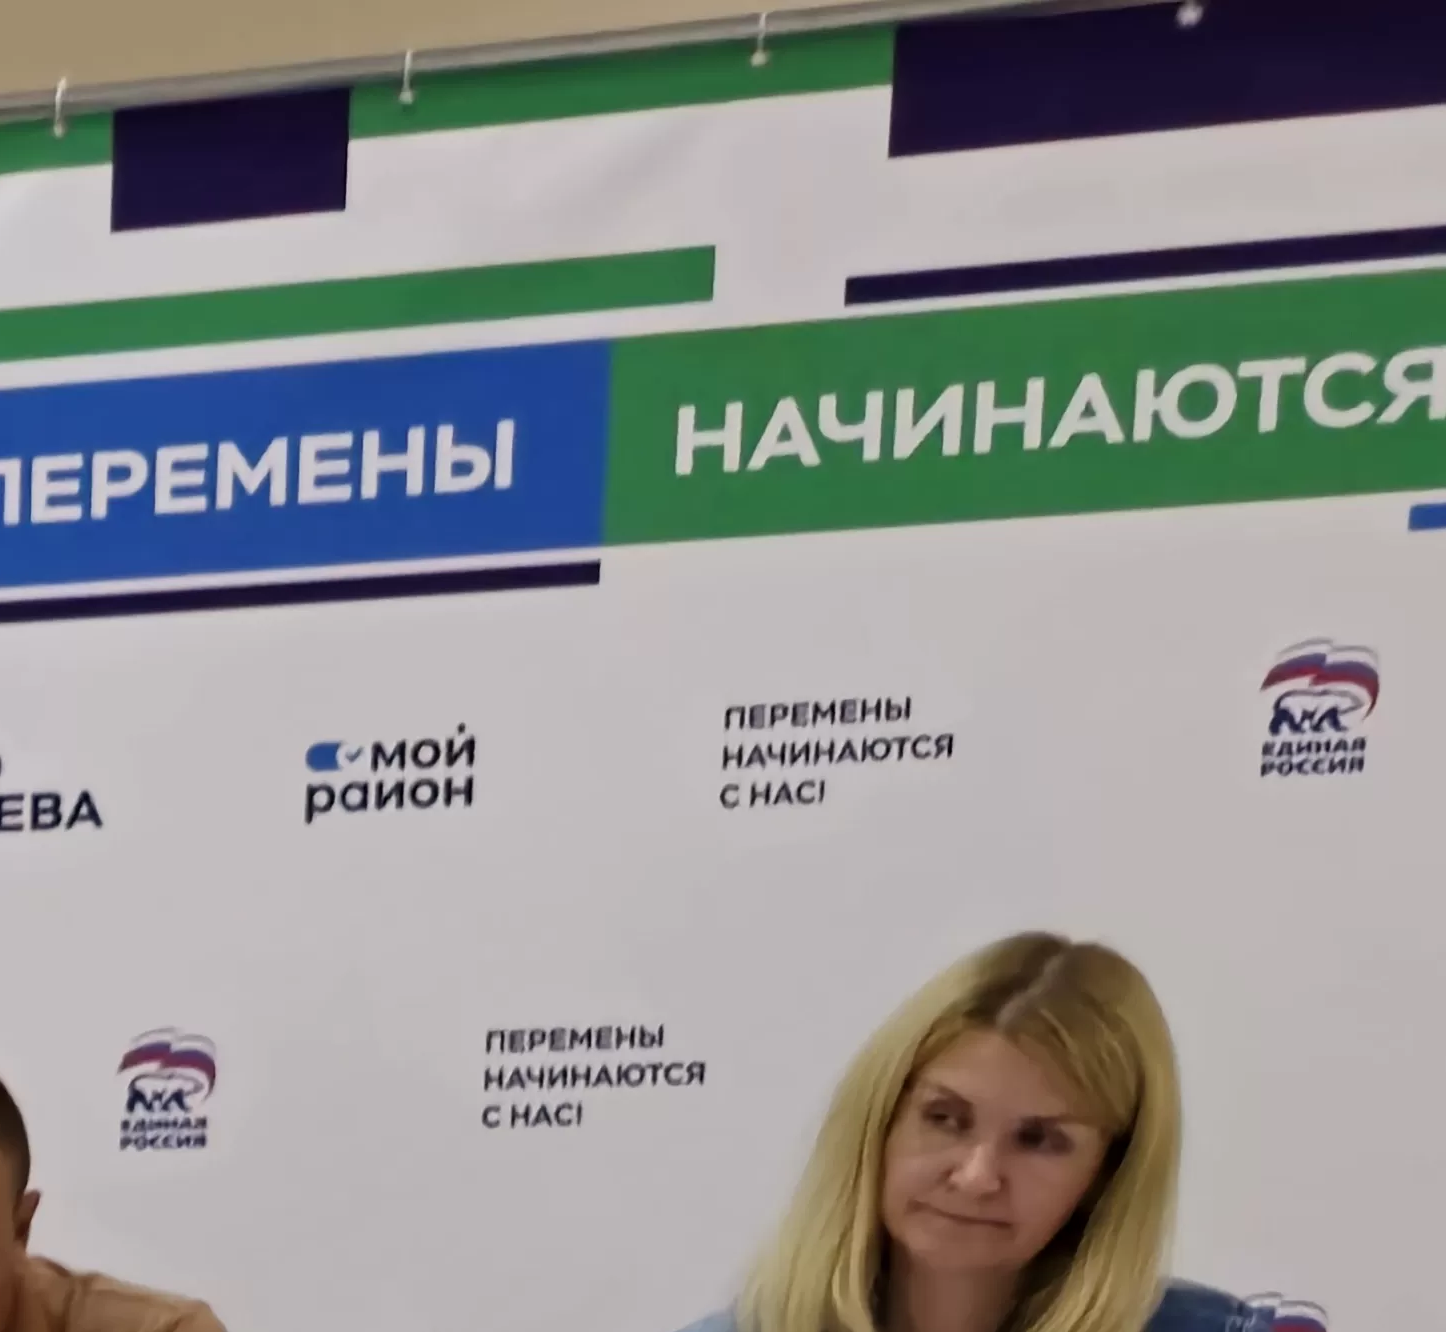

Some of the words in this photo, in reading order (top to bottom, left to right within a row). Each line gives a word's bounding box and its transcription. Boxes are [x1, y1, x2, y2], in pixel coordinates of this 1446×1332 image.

[674, 344, 1446, 475] НАЧИНАЮТСЯ
[723, 696, 912, 732] ПЕРЕМЕНЫ
[371, 722, 477, 774] мой
[721, 733, 955, 771] НАЧИНАЮТСЯ
[1261, 756, 1366, 777] РОССИЯ
[304, 772, 475, 824] район
[720, 782, 741, 809] С
[749, 780, 826, 808] НАС!
[485, 1024, 665, 1054] ПЕРЕМЕНЫ
[483, 1061, 706, 1093] НАЧИНАЮТСЯ
[481, 1103, 502, 1129] С
[511, 1102, 584, 1128] НАС!
